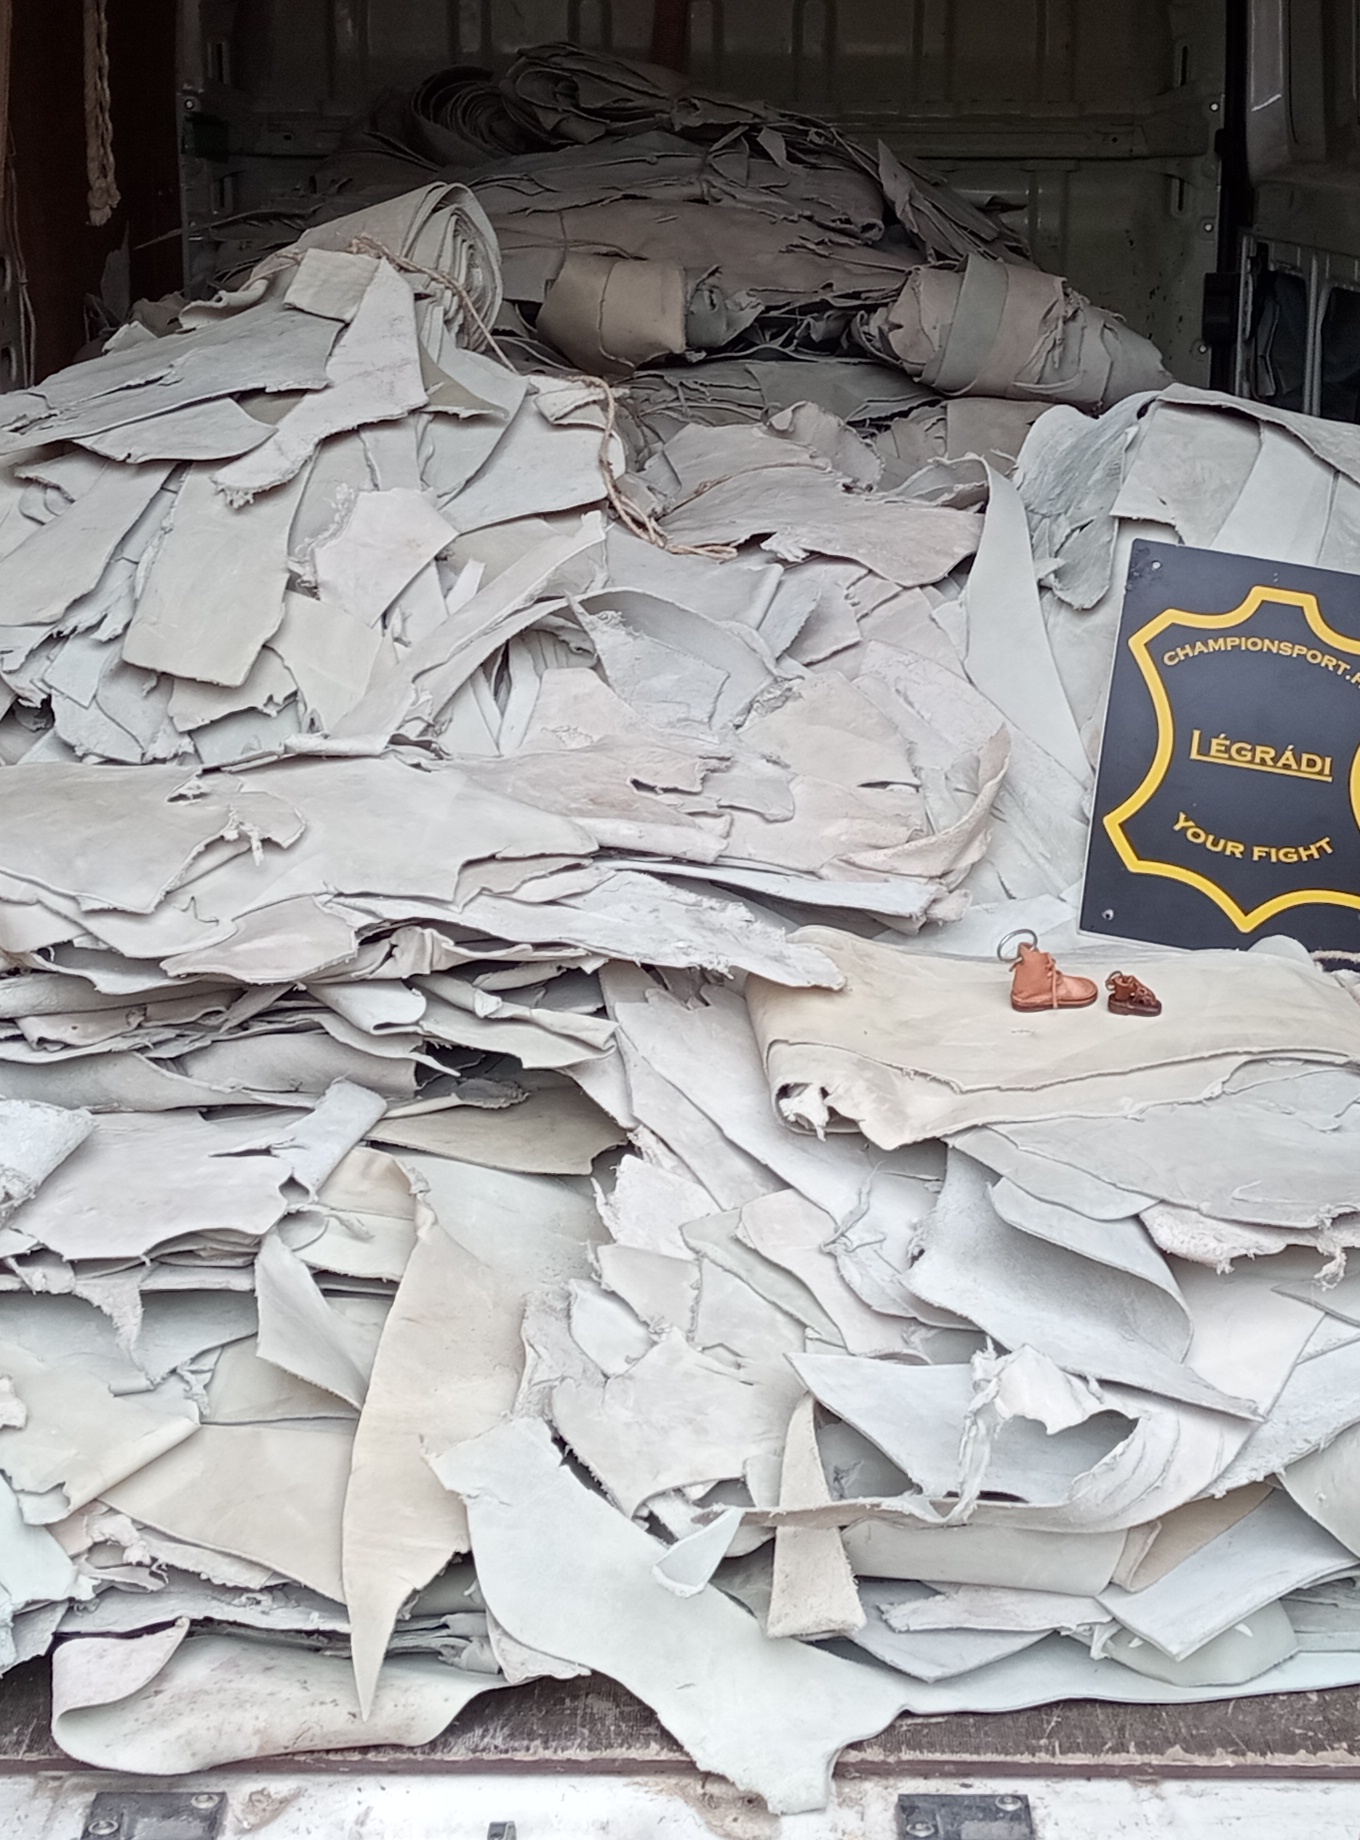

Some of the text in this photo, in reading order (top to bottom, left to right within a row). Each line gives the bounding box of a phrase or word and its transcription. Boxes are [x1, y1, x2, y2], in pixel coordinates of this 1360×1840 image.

[1190, 729, 1332, 780] LÉGRÁDI
[1173, 811, 1334, 863] YOUR FIGHT
